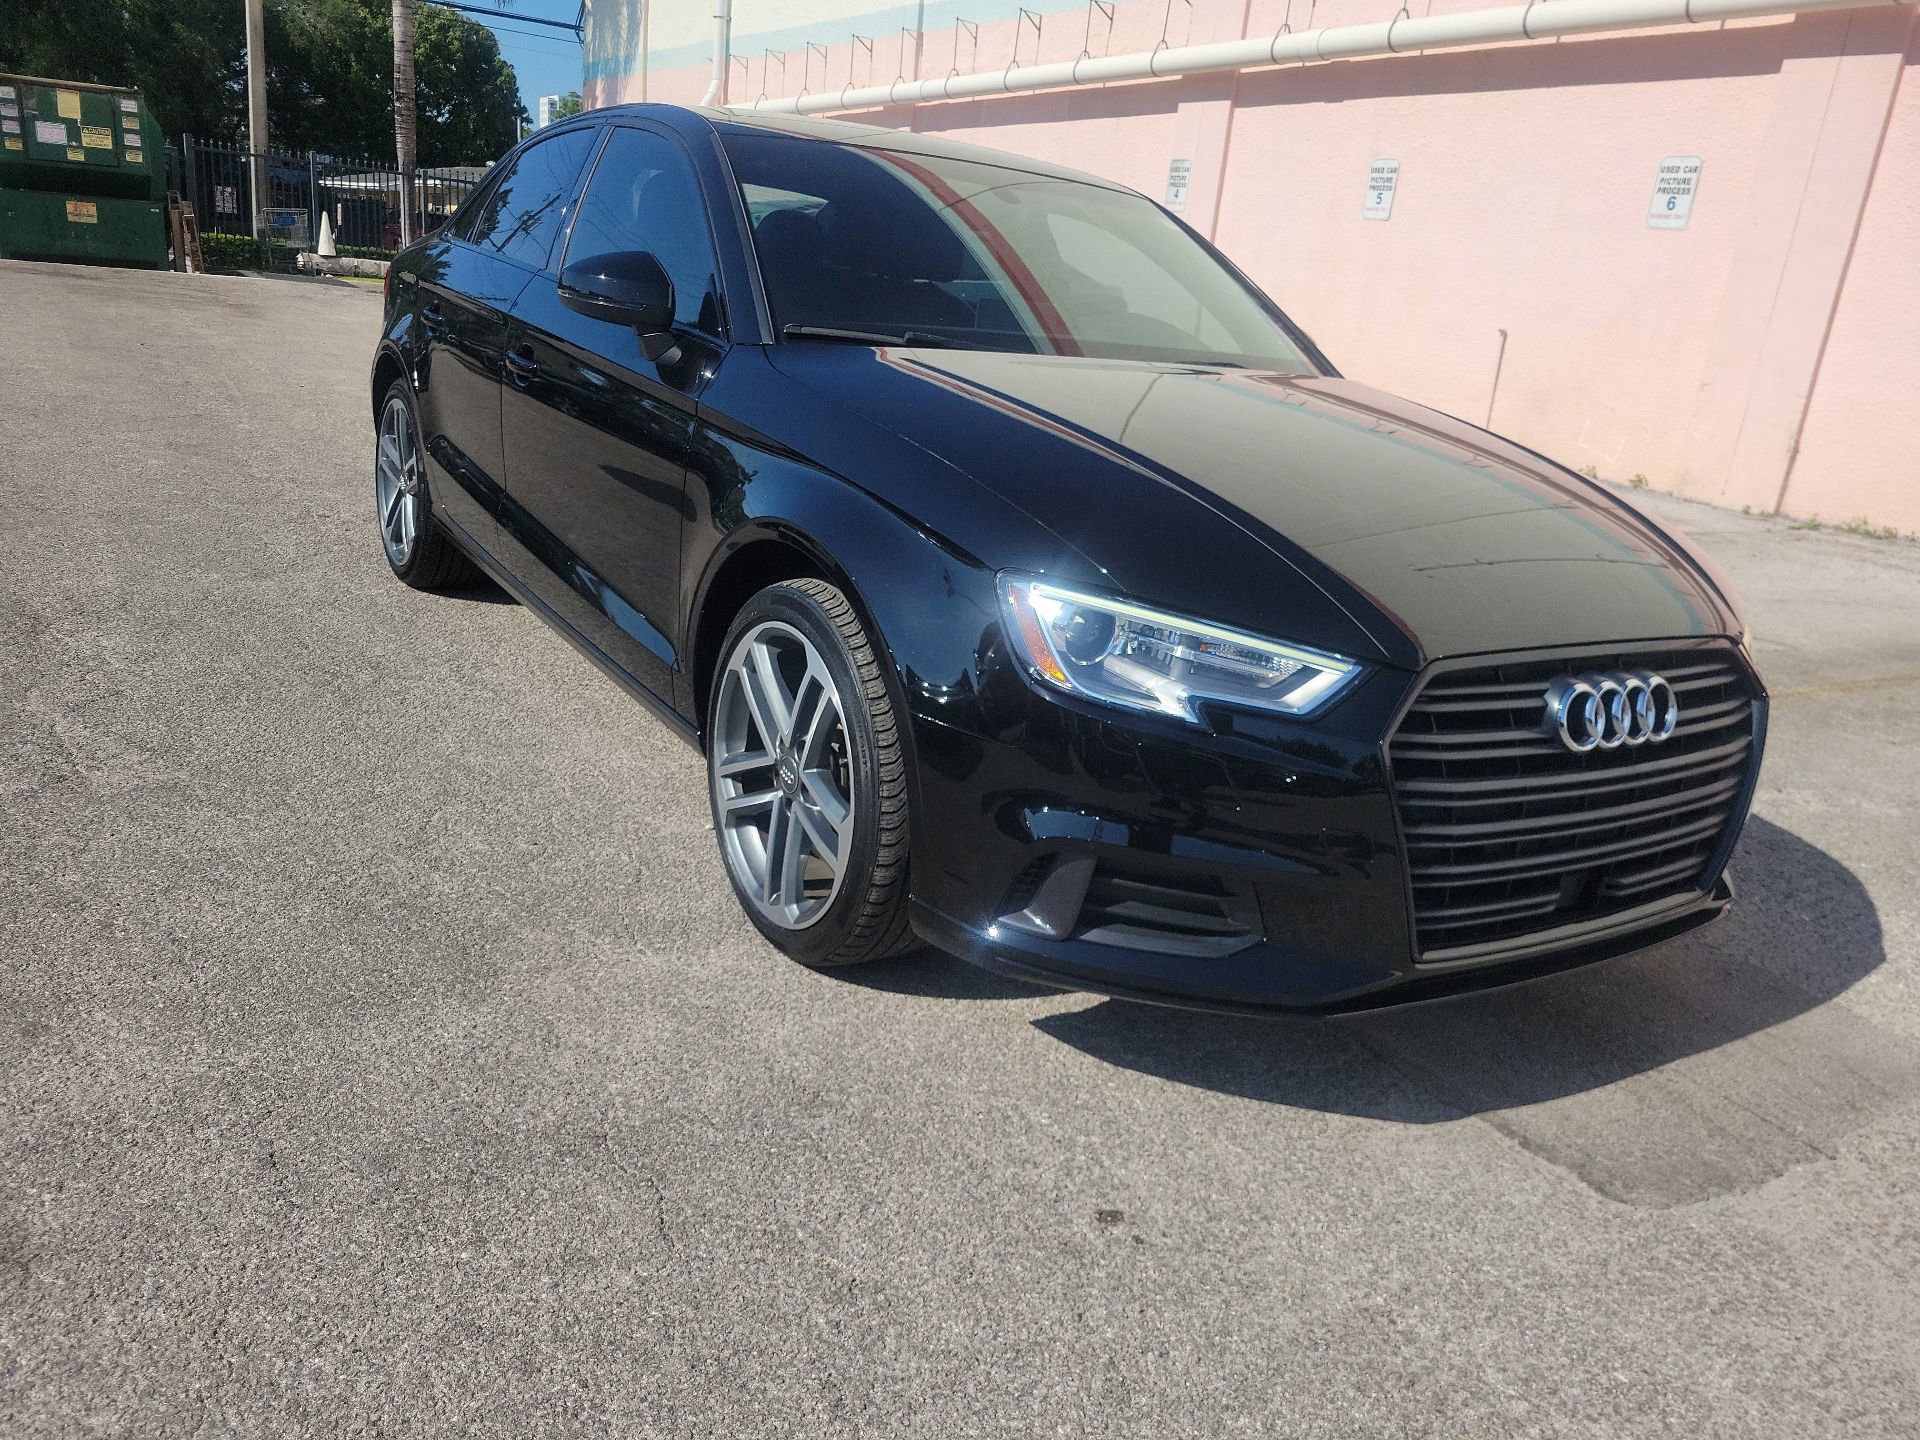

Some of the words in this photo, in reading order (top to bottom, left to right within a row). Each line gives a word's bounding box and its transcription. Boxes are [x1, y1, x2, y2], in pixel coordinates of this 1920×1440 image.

[1660, 165, 1681, 174] USED
[1683, 165, 1699, 174] CAR
[1659, 177, 1692, 186] PICTURE
[1656, 186, 1692, 195] PROCESS
[1376, 192, 1384, 205] 5
[1667, 196, 1677, 211] 6
